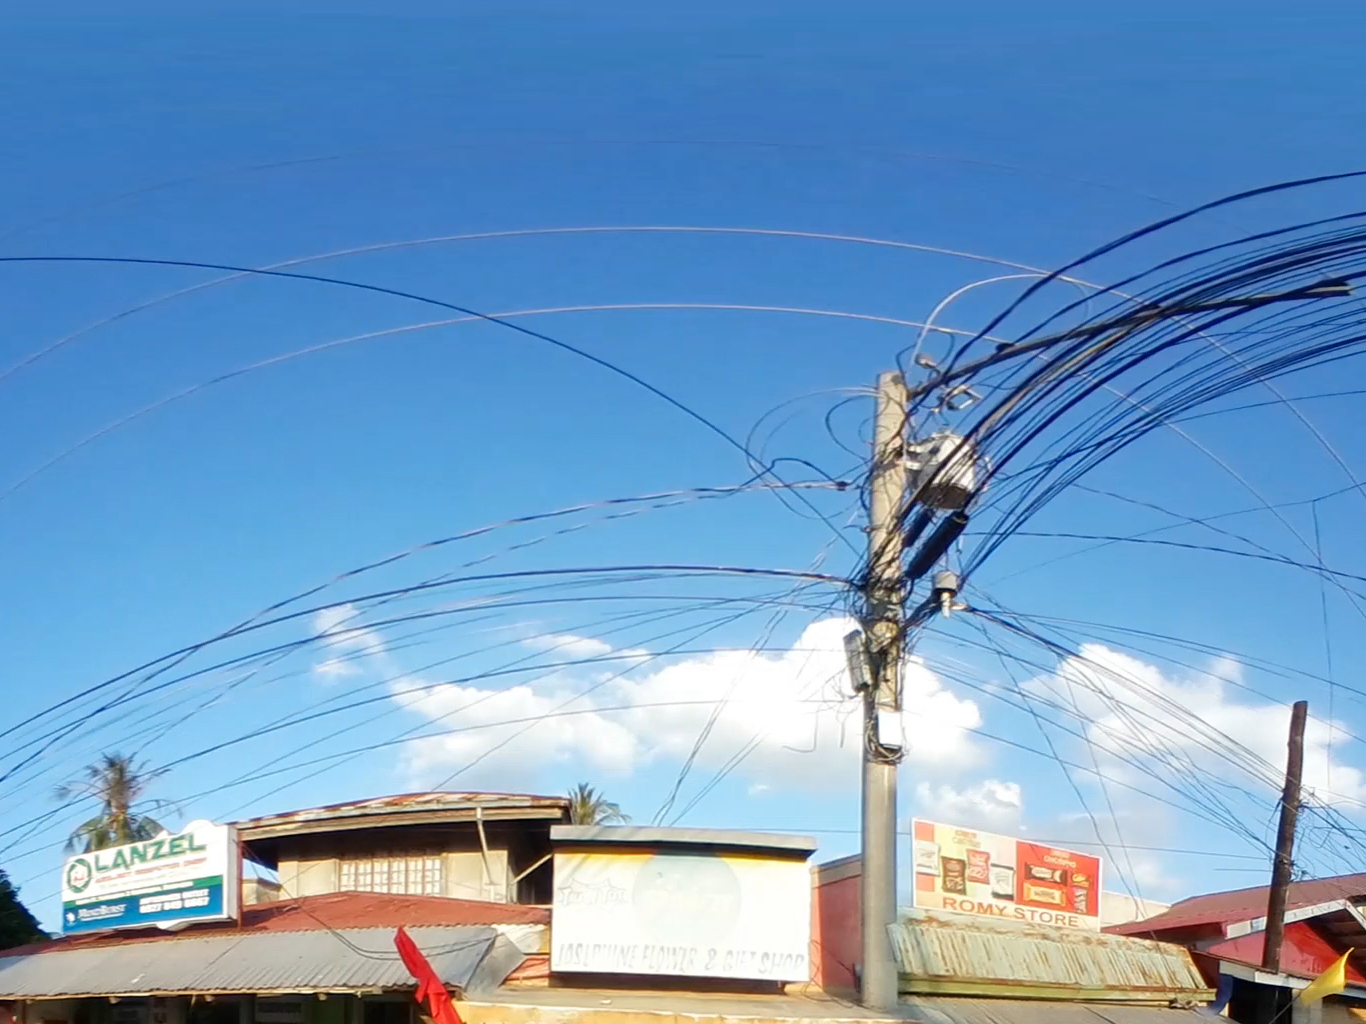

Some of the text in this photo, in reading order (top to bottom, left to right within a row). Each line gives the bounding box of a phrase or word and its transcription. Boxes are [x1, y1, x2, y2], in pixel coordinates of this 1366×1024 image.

[95, 833, 208, 872] LANZEL
[942, 897, 1080, 928] ROMY STORE
[704, 947, 717, 972] &
[758, 950, 806, 975] SHOP
